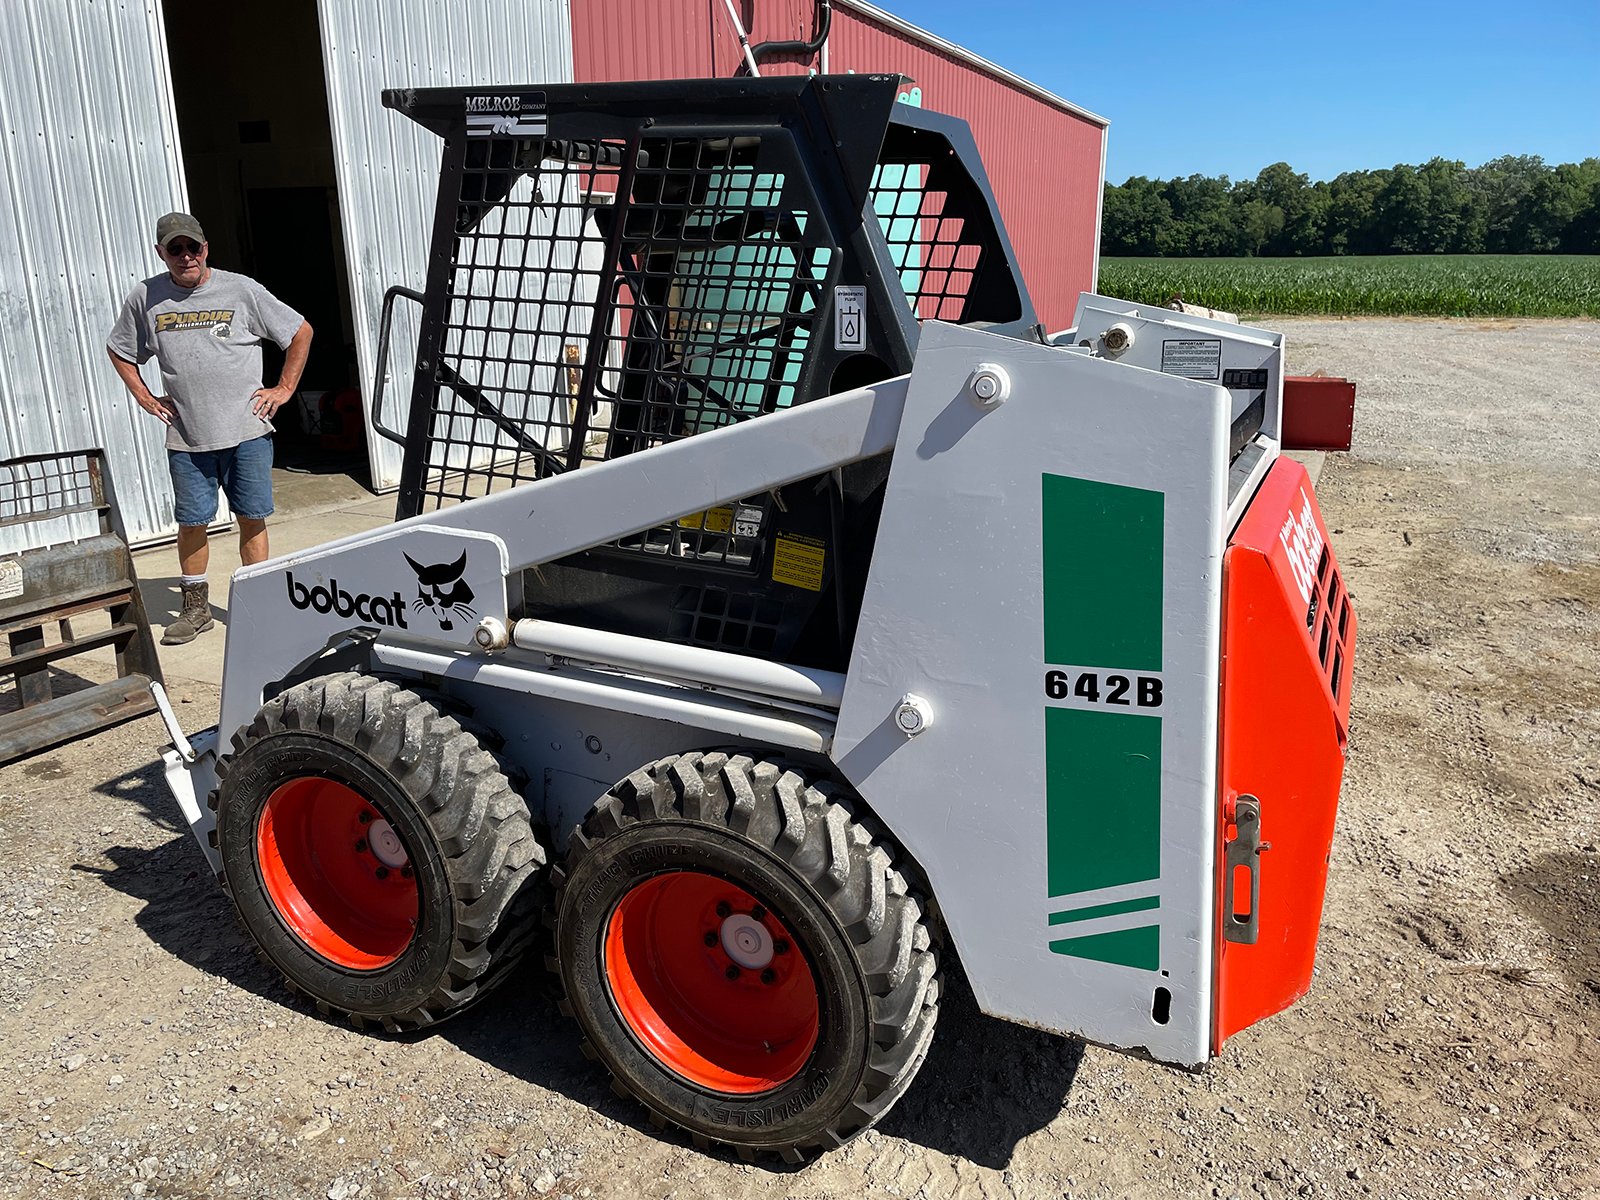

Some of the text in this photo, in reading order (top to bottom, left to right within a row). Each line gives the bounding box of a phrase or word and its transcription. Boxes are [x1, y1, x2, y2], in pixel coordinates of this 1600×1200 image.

[465, 96, 521, 112] MELROE
[154, 310, 235, 334] PURDUE
[1279, 485, 1324, 605] bobcat
[285, 570, 409, 630] bobcat
[1044, 669, 1164, 708] 642B
[711, 1070, 830, 1128] CARLISLE
